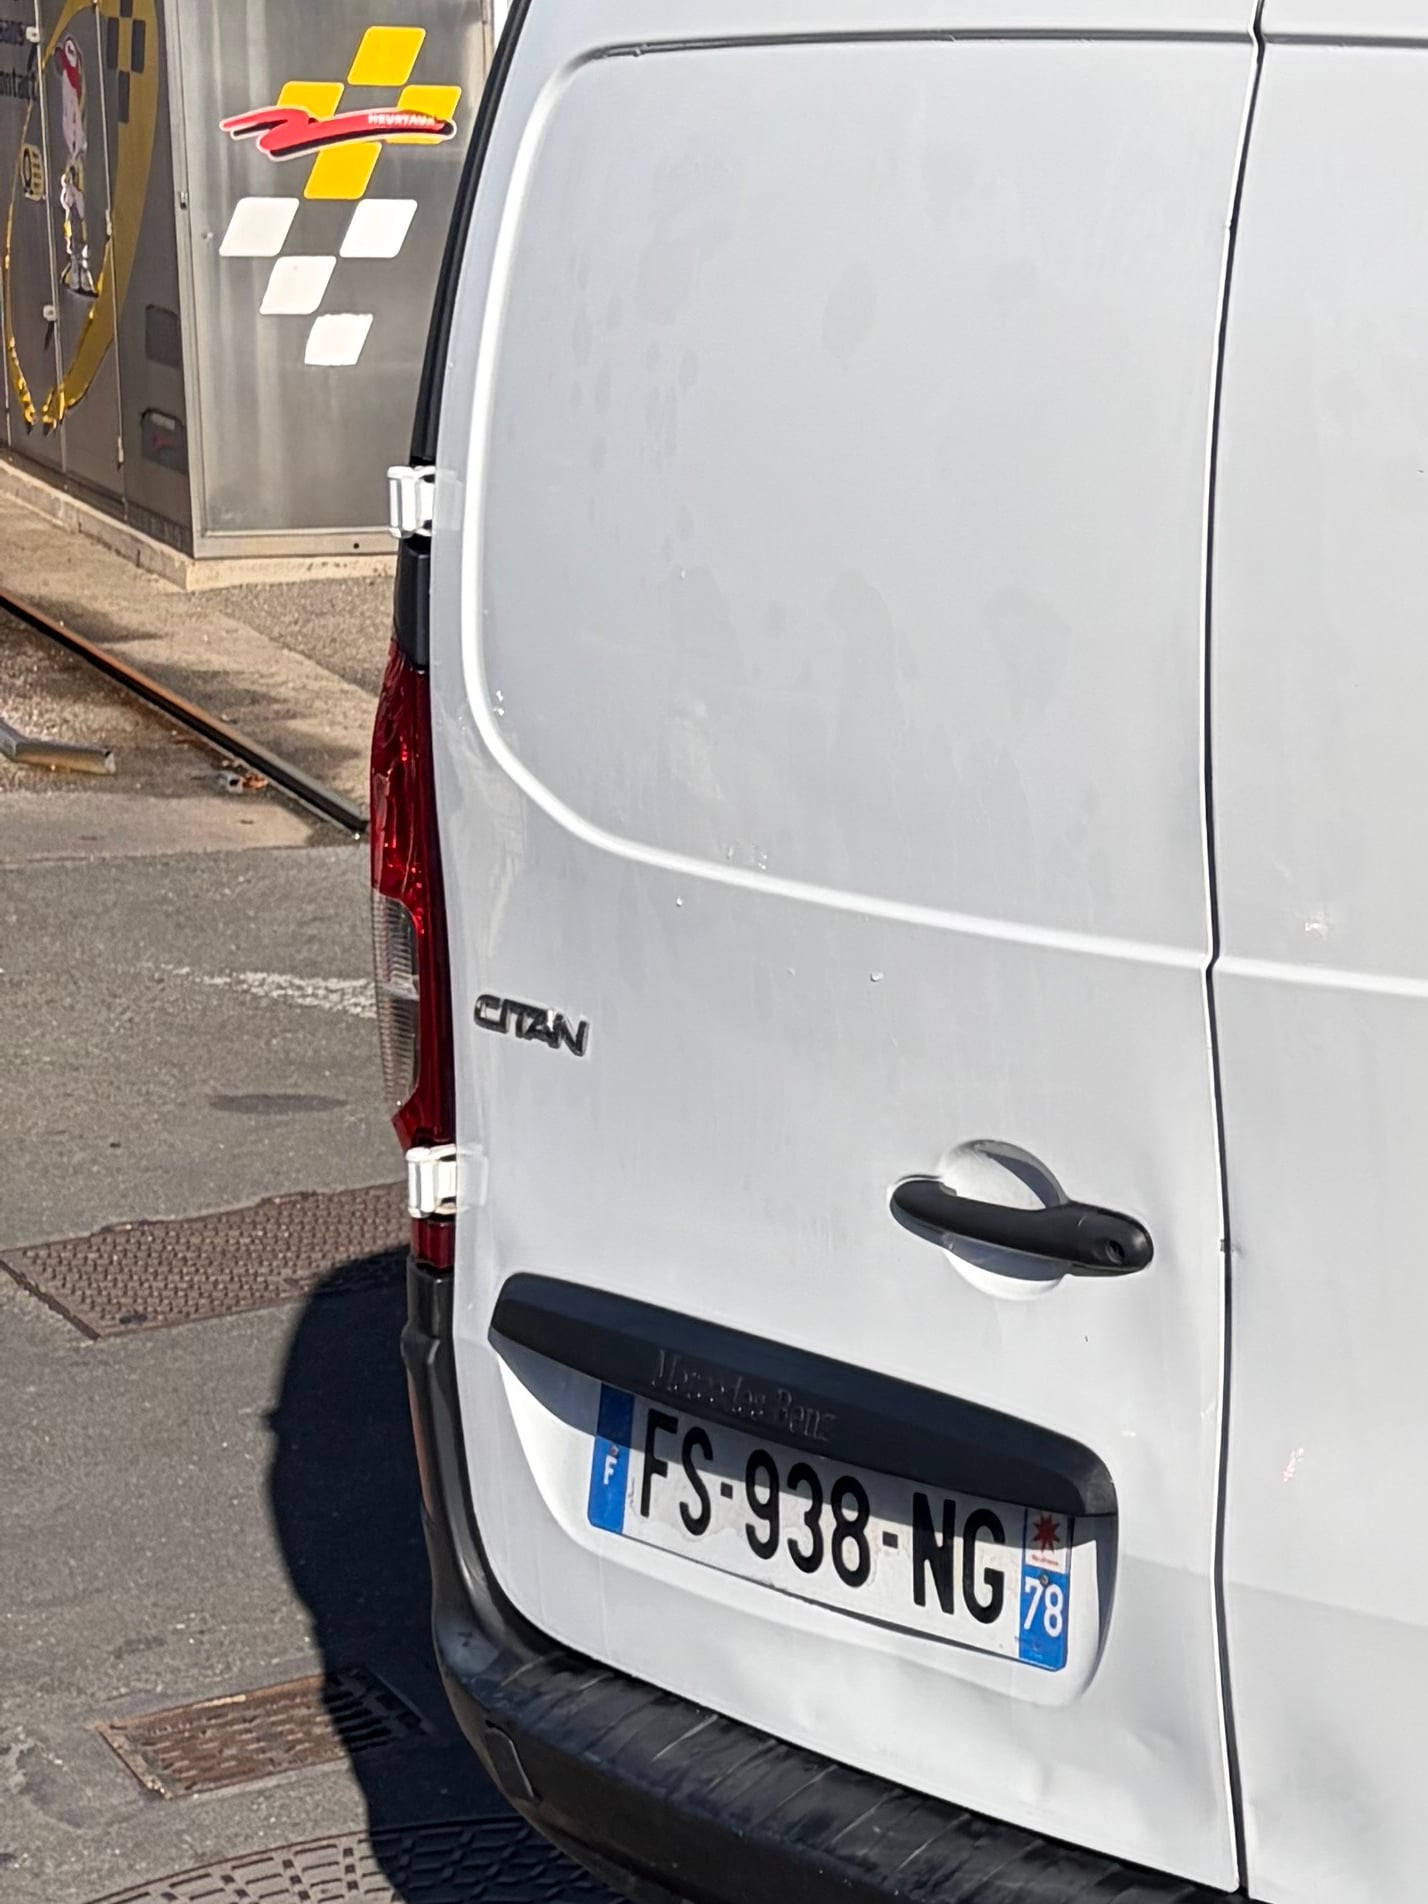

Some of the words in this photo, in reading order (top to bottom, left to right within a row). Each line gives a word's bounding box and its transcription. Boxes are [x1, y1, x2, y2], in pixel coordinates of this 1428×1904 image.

[473, 994, 590, 1057] CITAN
[602, 1455, 618, 1487] F
[640, 1408, 1006, 1625] FS-938-NG
[1023, 1576, 1064, 1638] 78
